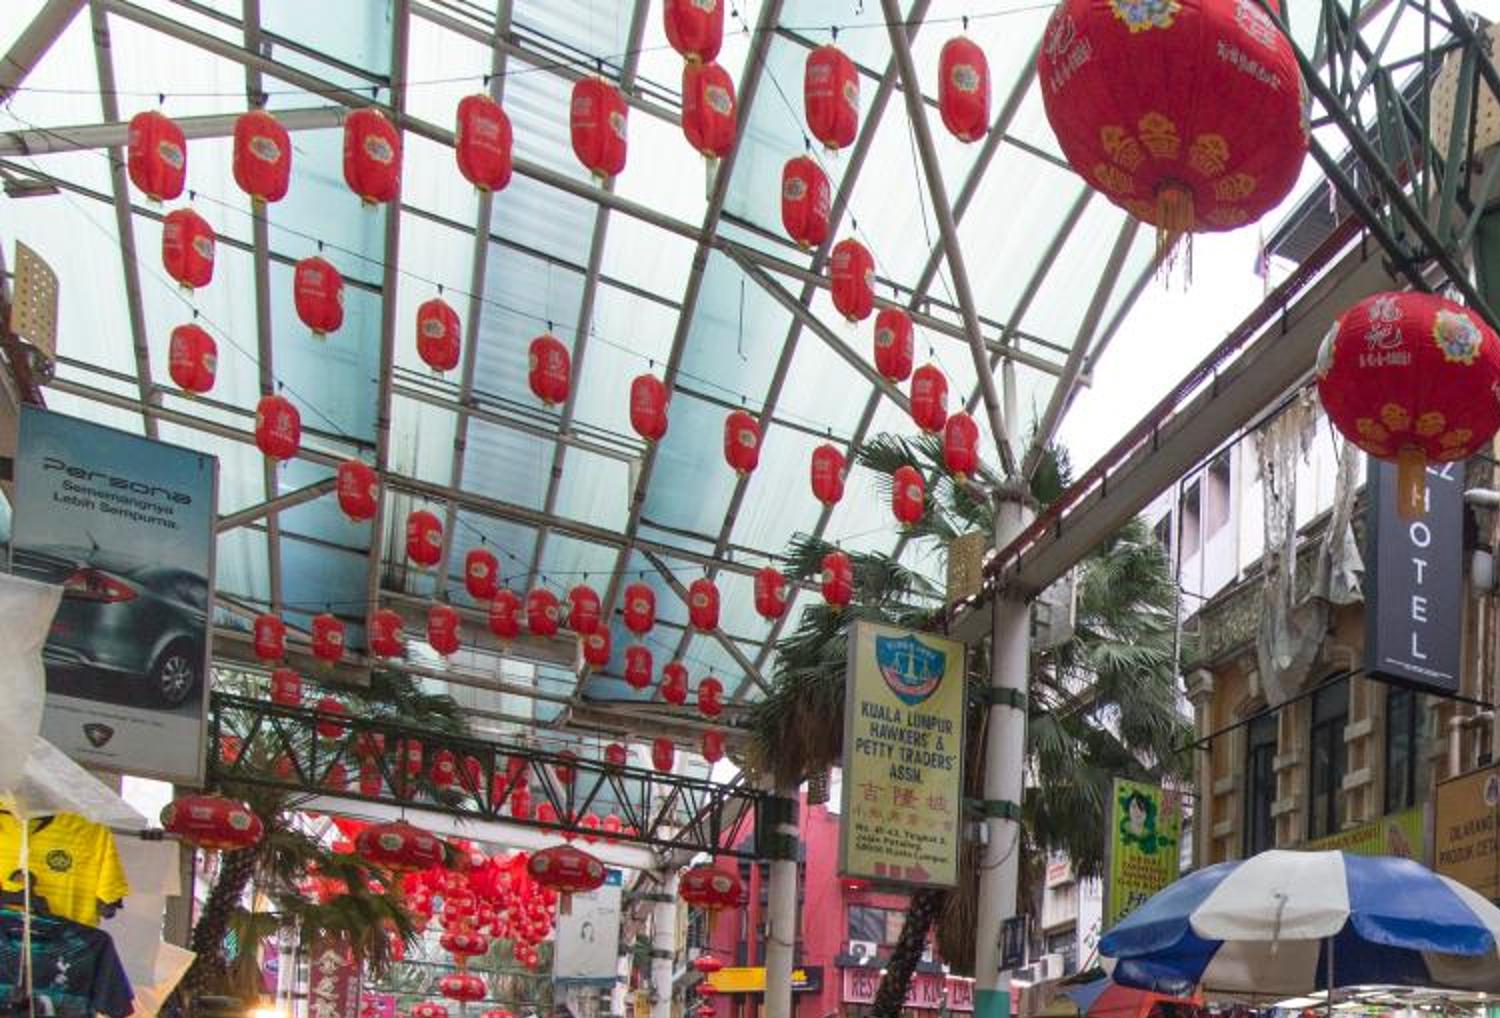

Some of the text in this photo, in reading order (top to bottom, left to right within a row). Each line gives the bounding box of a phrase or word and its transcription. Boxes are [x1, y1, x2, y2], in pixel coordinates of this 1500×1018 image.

[42, 456, 193, 505] Persona
[1408, 481, 1432, 660] HOTEL
[861, 701, 953, 735] KUALA LUMPUR
[855, 737, 894, 760] PETTY
